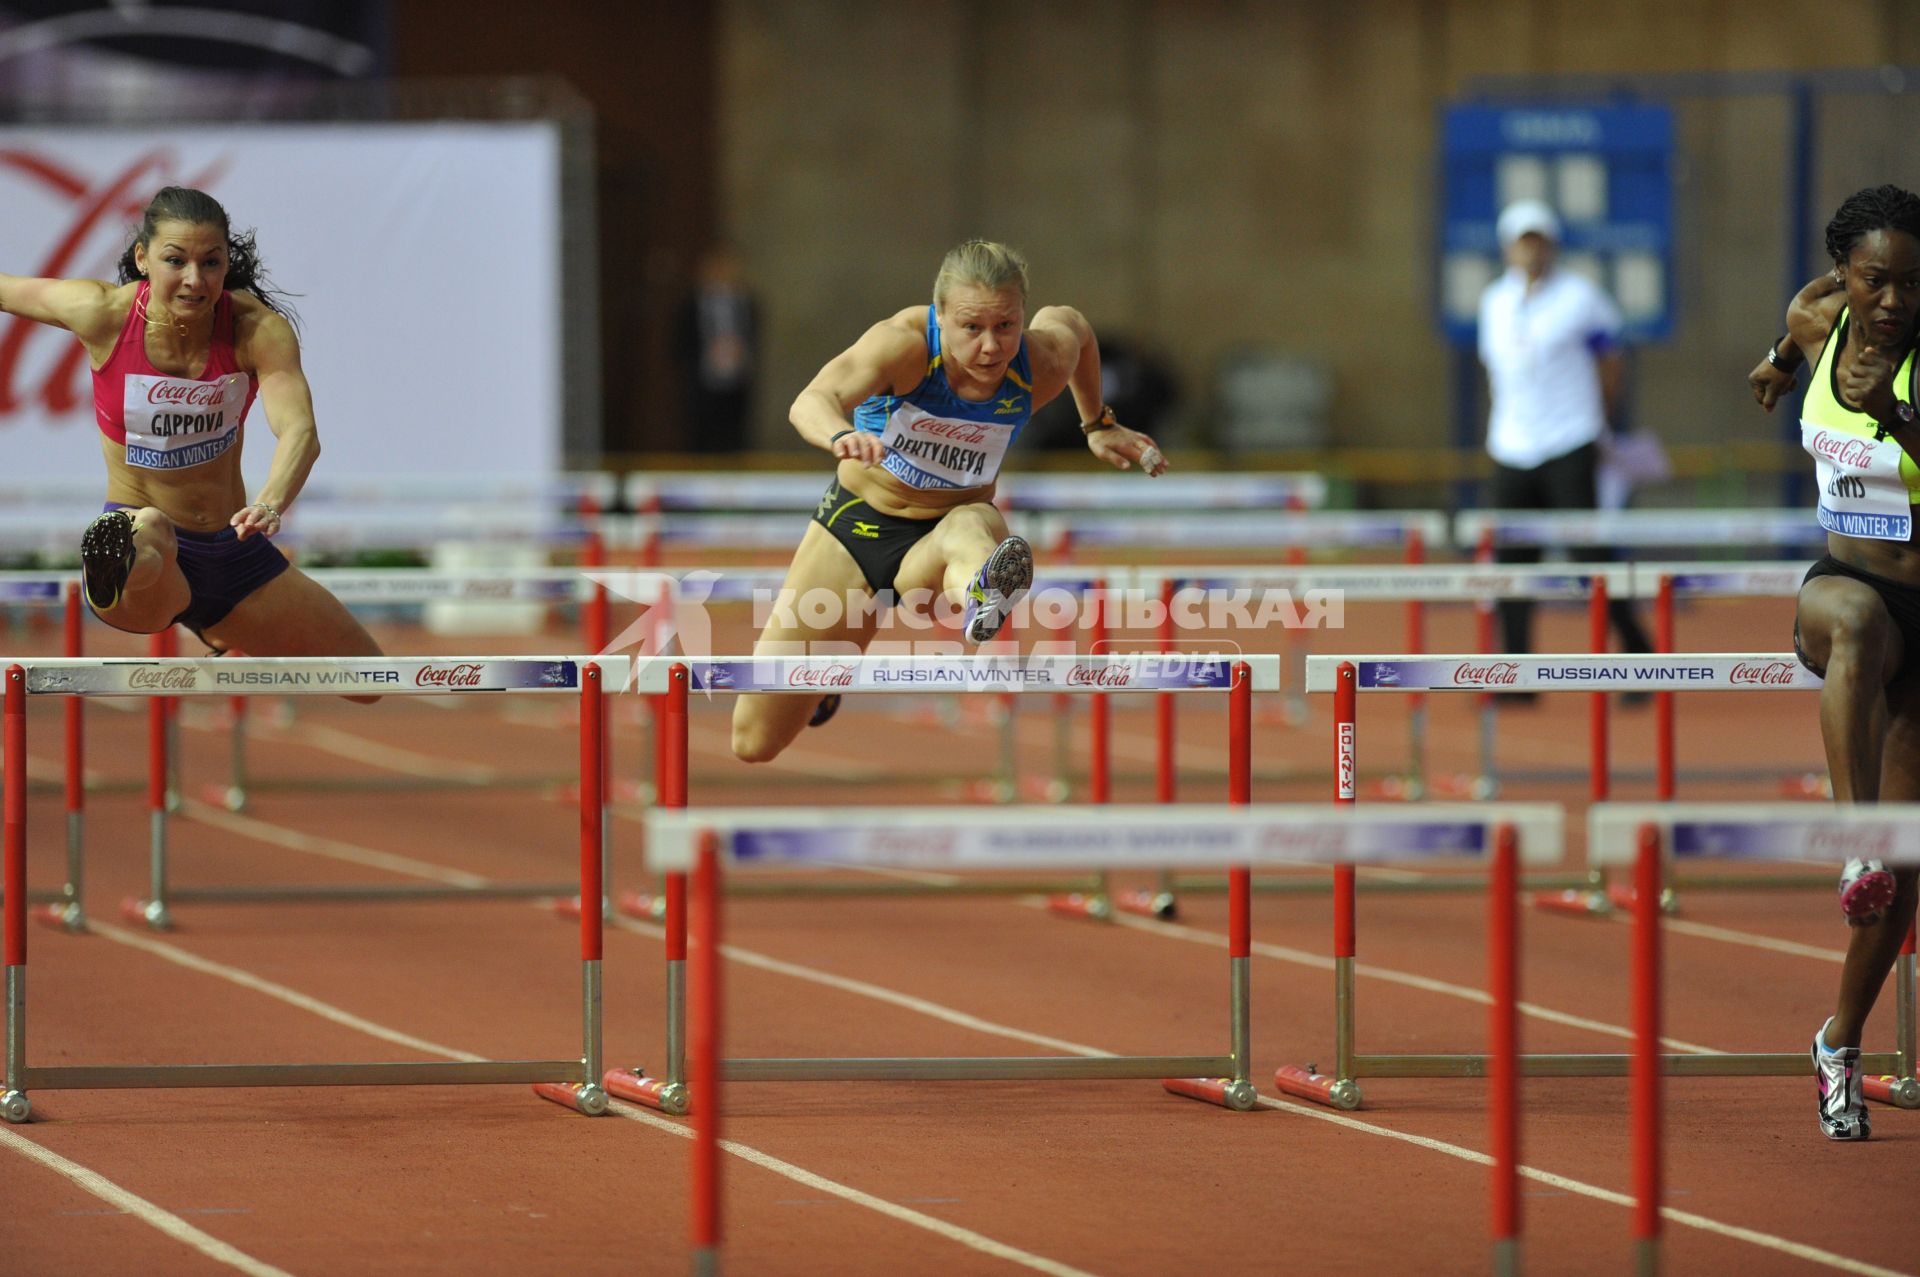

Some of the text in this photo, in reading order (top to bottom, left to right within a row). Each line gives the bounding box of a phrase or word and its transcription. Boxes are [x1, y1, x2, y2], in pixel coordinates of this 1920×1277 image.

[147, 379, 226, 406] Coca-Cola
[151, 410, 224, 437] GAPPOVA
[911, 417, 991, 444] Coca-Cola
[129, 446, 180, 468] RUSSIAN
[183, 440, 225, 465] WINTER
[892, 432, 987, 476] DEKTYAREVA
[1813, 430, 1878, 470] Coca-Cola
[1842, 513, 1889, 536] WINTER
[1892, 518, 1909, 538] '13
[128, 664, 485, 689] Coca-Cola RUSSIAN WINTER Coca-Cola
[788, 664, 1132, 687] Coca-Cola RUSSIAN WINTER Coca-Cola
[1453, 662, 1798, 685] Coca-Cola RUSSIAN WINTER Coca-Cola
[1341, 725, 1353, 790] POLANIK
